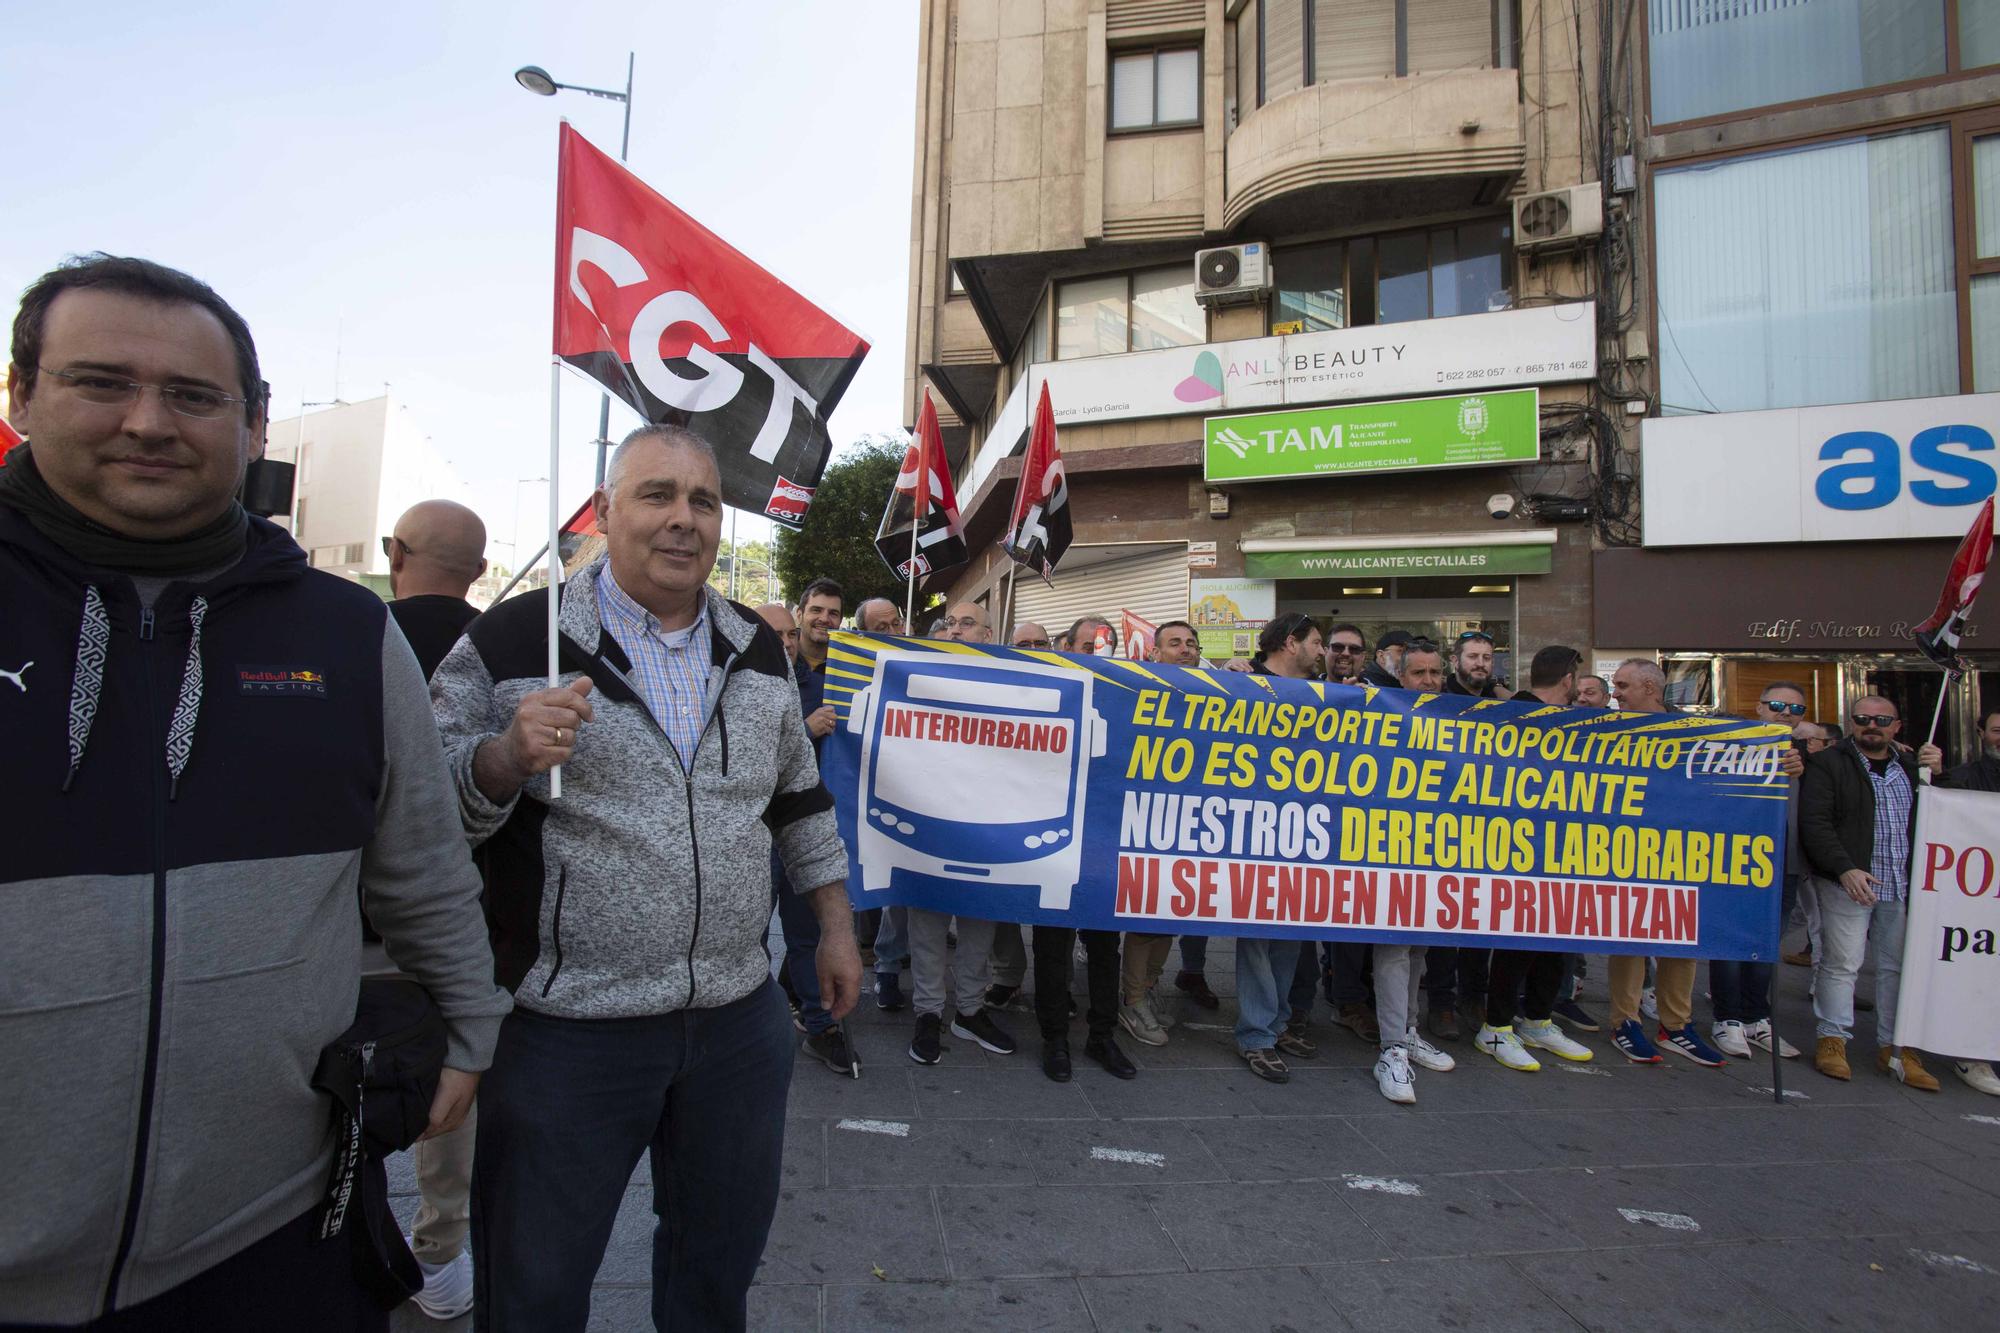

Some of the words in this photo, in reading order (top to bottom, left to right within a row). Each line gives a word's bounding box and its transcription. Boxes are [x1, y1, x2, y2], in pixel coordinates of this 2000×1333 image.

[569, 226, 818, 465] CGT
[1265, 375, 1308, 387] CENTRO
[1312, 370, 1364, 383] ESTÉTICO
[1446, 371, 1464, 381] 622
[1466, 370, 1484, 379] 282
[1487, 367, 1505, 377] 057
[1525, 364, 1545, 374] 865
[1548, 362, 1565, 372] 781
[1569, 360, 1588, 370] 462
[1083, 405, 1103, 416] Lydia
[1104, 402, 1130, 412] García
[1259, 424, 1343, 454] TAM
[769, 507, 806, 522] CGT
[1301, 554, 1487, 570] WWW.ALICANTE.VECTALIA.ES
[1748, 619, 1801, 643] Edif.
[1809, 621, 1882, 638] Nueva
[243, 683, 325, 692] RACING
[885, 708, 1068, 754] INTERURBANO
[1132, 689, 1175, 728] EL
[1181, 694, 1403, 747] TRANSPORTE
[1407, 716, 1681, 770] METROPOLITANO
[1686, 739, 1779, 785] (TAM)
[1126, 735, 1195, 784] NO
[1202, 741, 1259, 788] ES
[1266, 747, 1378, 797] SOLO
[1387, 757, 1446, 801] DE
[1449, 763, 1648, 816] ALICANTE
[1120, 790, 1331, 860] NUESTROS
[1339, 806, 1535, 873] DERECHOS
[1544, 820, 1775, 888] LABORABLES
[1921, 842, 2000, 898] PO
[1115, 856, 1160, 915] NI
[1170, 859, 1219, 918] SE
[1228, 863, 1378, 926] VENDEN
[1387, 872, 1427, 928] NI
[1436, 874, 1480, 930] SE
[1489, 878, 1697, 942] PRIVATIZAN
[1938, 925, 2000, 963] pa
